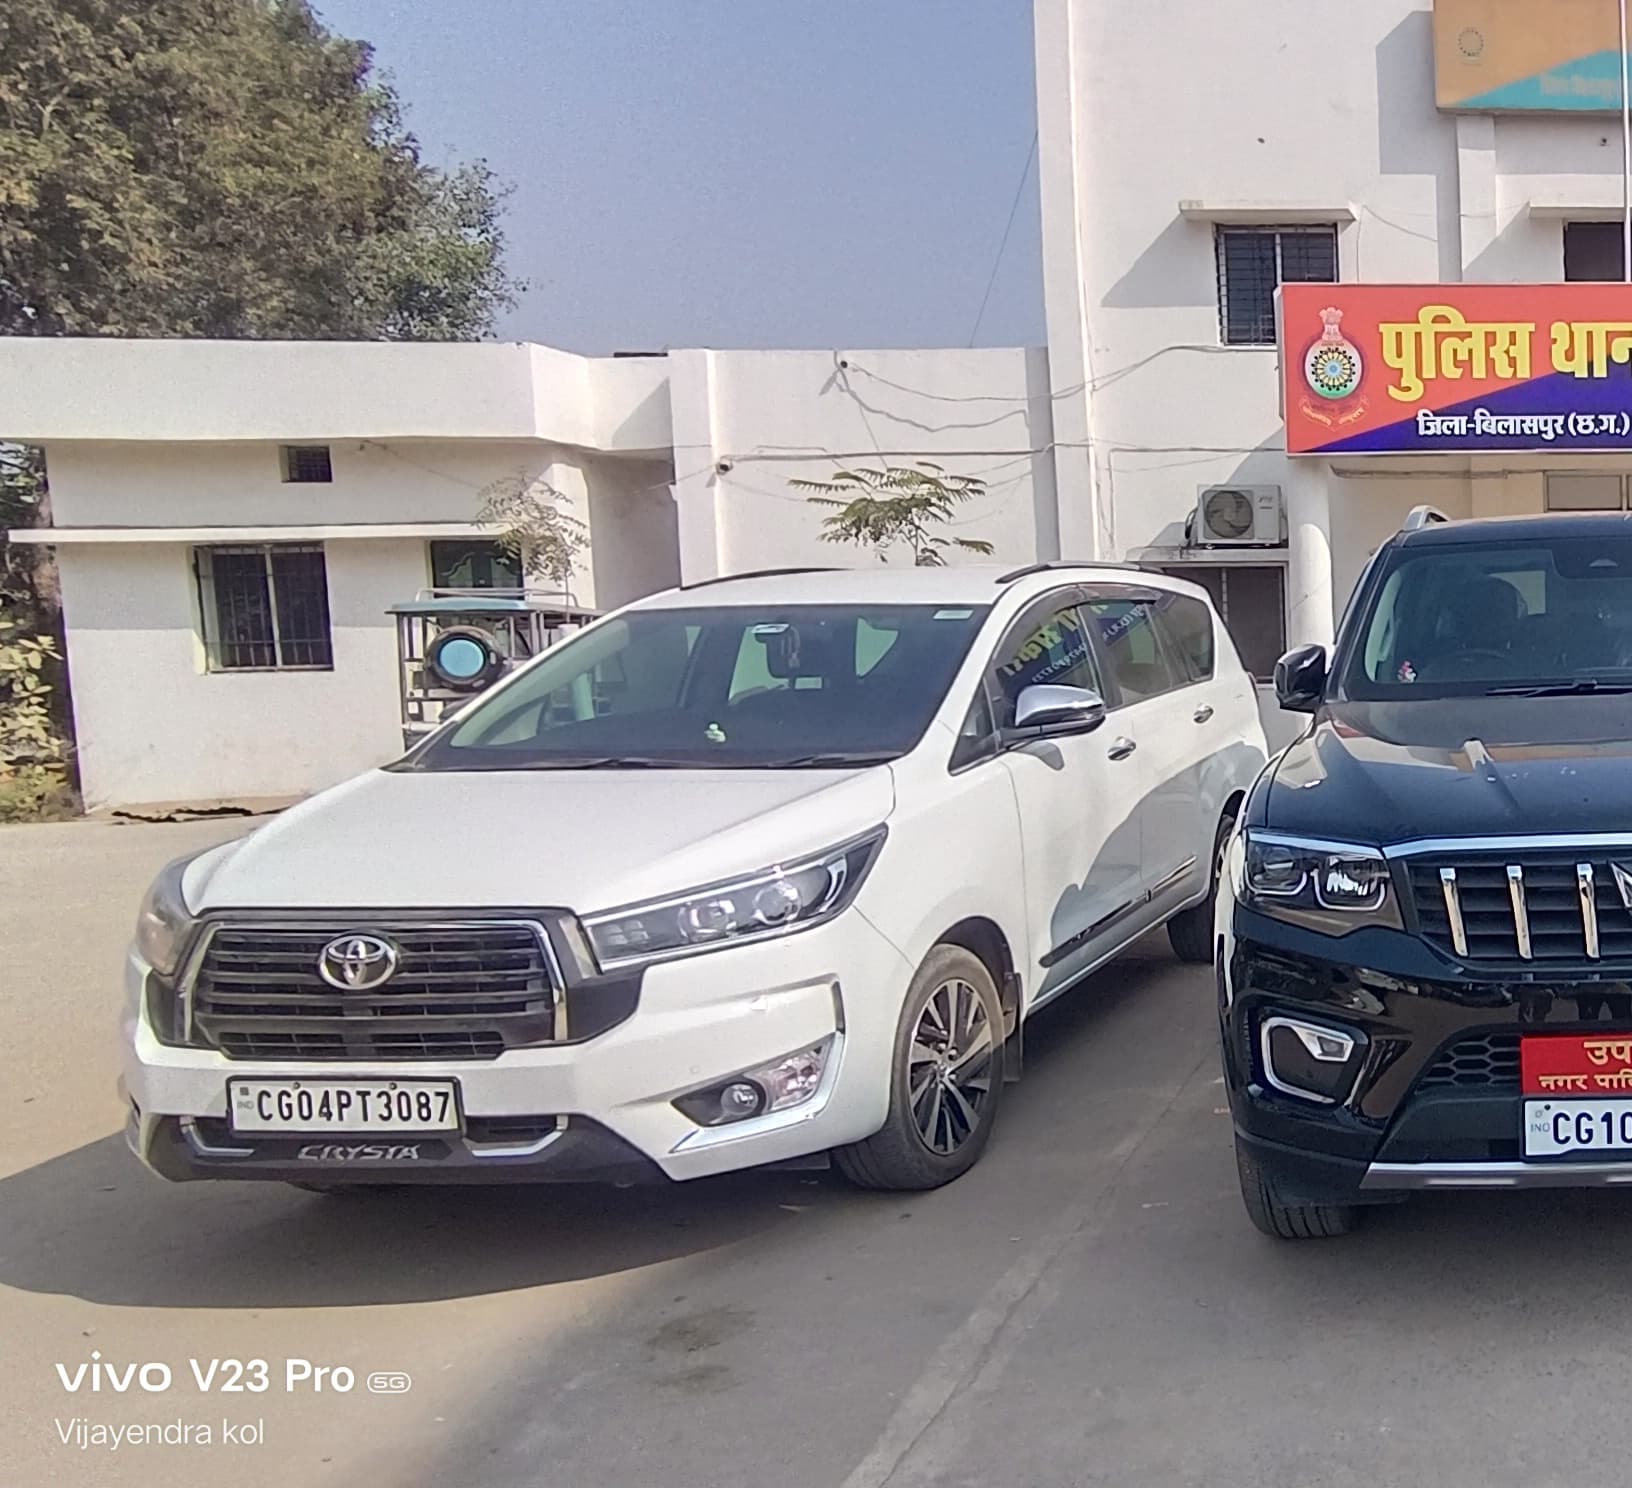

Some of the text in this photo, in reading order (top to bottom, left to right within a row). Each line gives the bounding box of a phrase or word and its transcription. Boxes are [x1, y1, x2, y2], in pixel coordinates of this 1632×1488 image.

[1379, 305, 1536, 402] पुलिस
[1416, 408, 1565, 441] जिला-बिलासपुर
[1568, 413, 1629, 438] (छ.ग.)
[1538, 1074, 1588, 1091] नगर
[256, 1089, 451, 1122] CG04PT3087
[297, 1144, 421, 1161] CRYSTA
